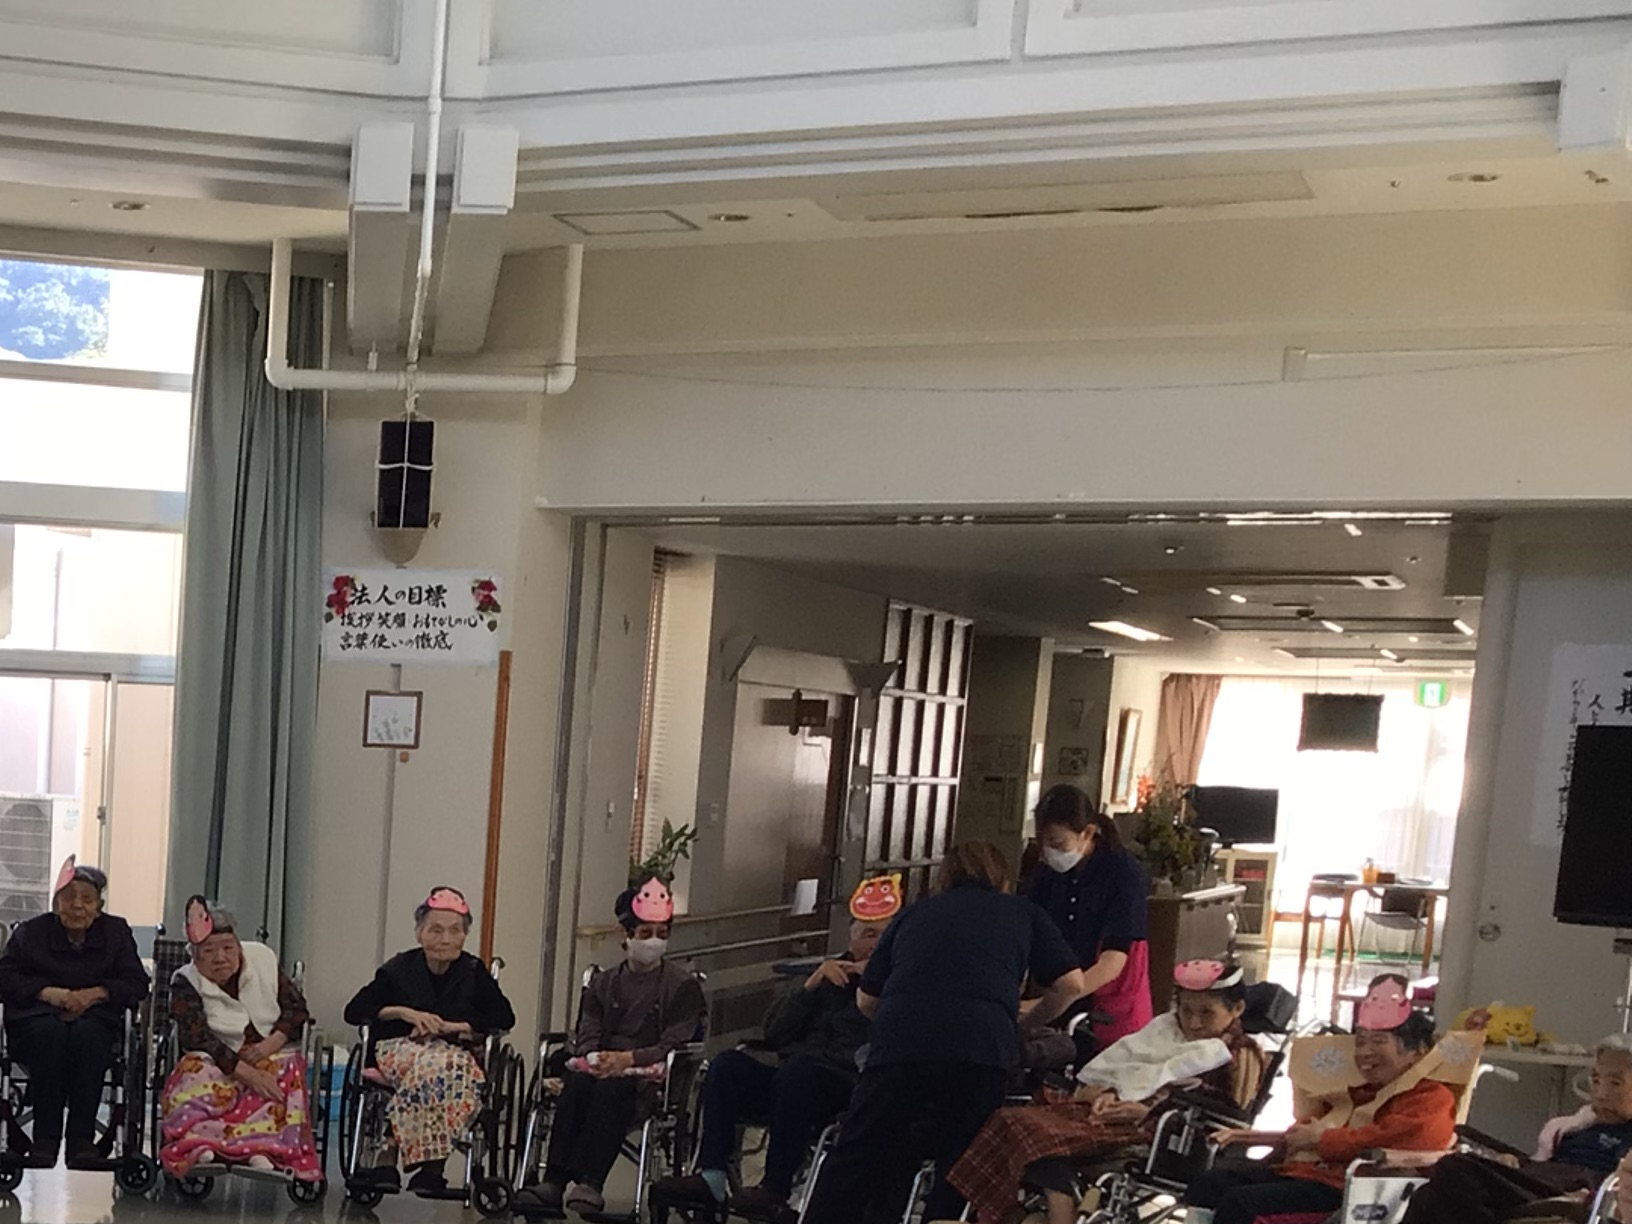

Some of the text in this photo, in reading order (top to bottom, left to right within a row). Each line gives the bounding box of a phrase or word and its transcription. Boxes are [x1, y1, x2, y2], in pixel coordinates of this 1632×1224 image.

[350, 583, 448, 609] 法人の目標
[339, 629, 454, 651] 言葉使いの徹底
